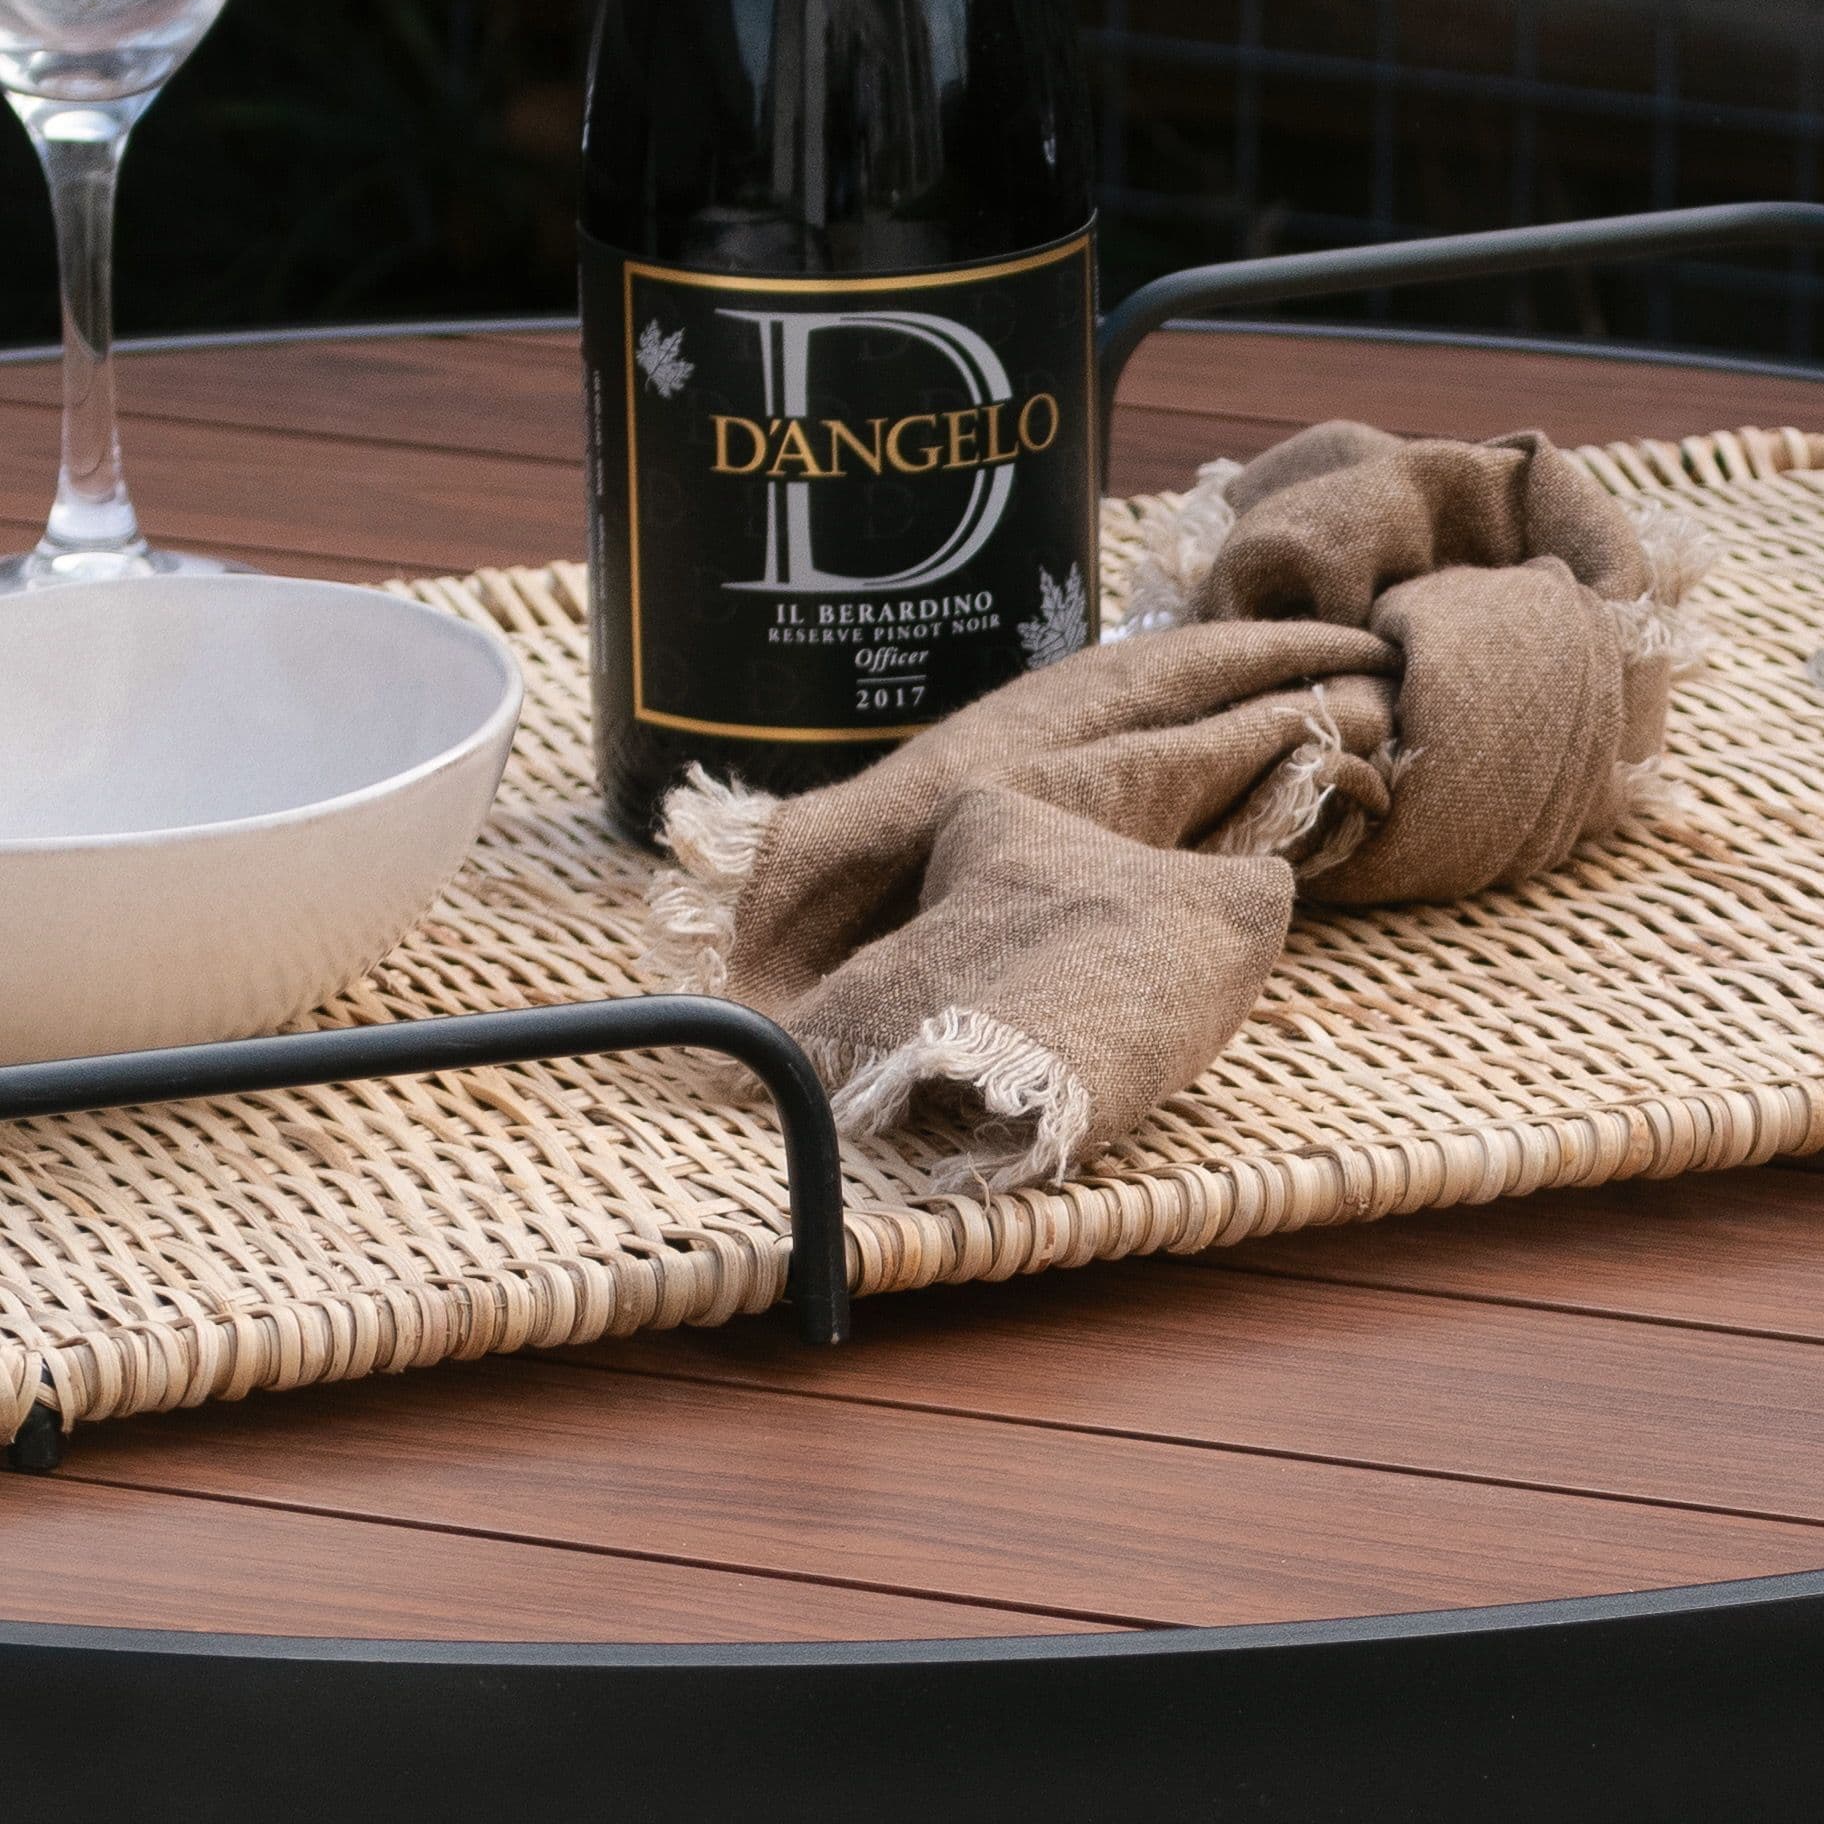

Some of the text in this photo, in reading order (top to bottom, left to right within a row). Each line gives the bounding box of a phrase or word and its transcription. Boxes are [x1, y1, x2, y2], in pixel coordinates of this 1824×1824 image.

[709, 392, 1060, 478] D'ANGELO
[714, 307, 1017, 594] D
[776, 590, 993, 625] IL BERARDINO
[767, 613, 1001, 644] RESERVE PINOT NOIR
[854, 645, 929, 672] Officer
[856, 685, 926, 709] 2017
